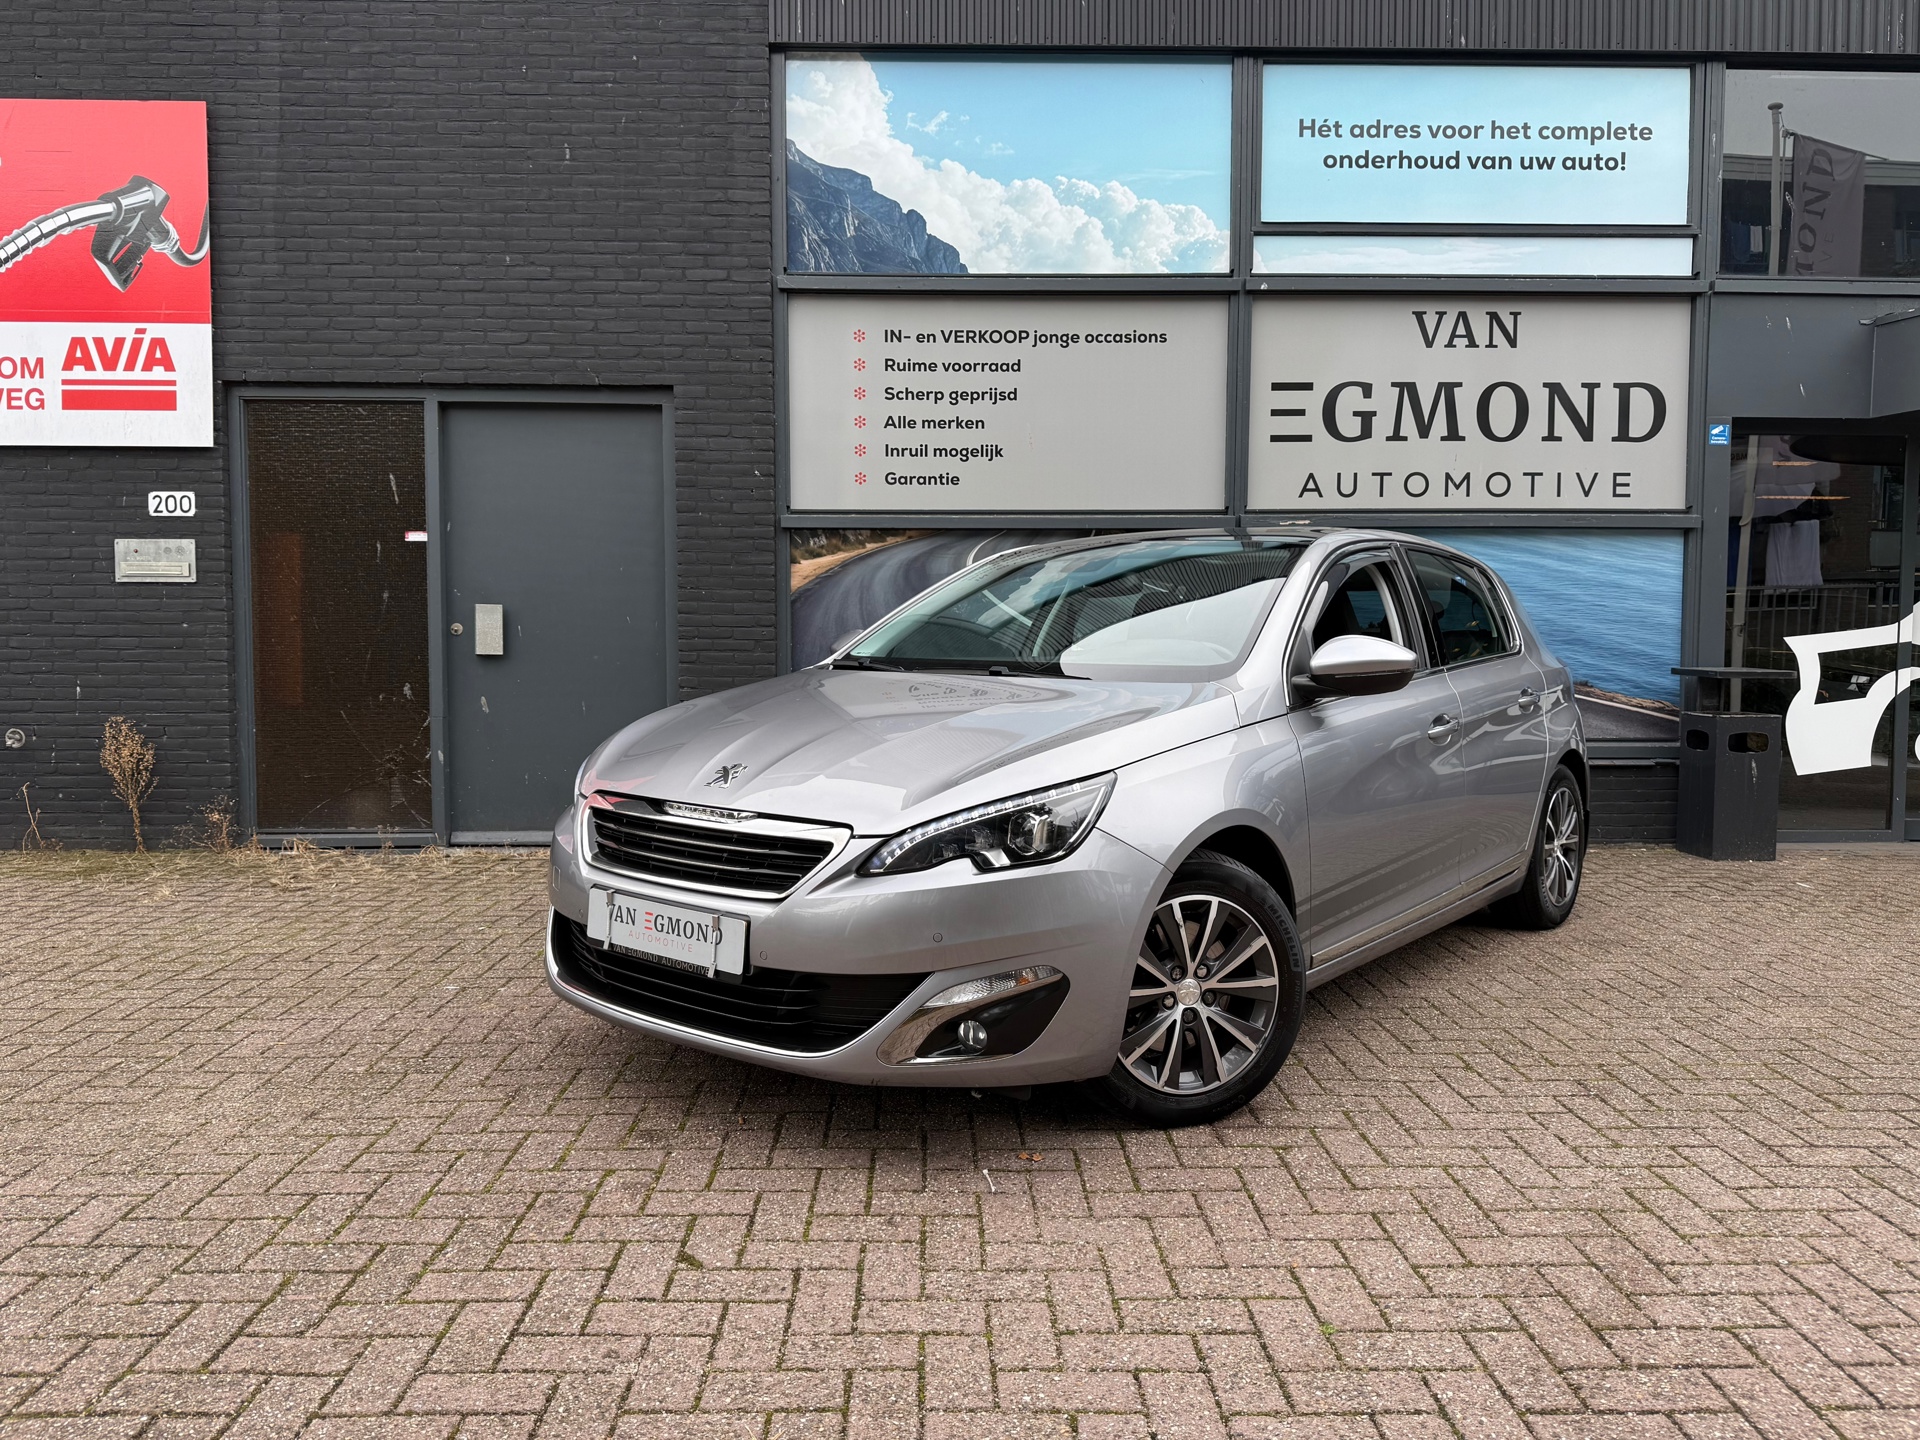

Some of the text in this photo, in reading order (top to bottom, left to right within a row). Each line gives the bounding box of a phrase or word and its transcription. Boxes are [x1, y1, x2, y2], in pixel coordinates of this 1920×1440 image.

[1299, 119, 1653, 145] Hét adres voor het complete
[1323, 150, 1626, 171] onderhoud van uw auto!
[884, 330, 1167, 348] IN- en VERKOOP jonge occasions
[1412, 311, 1521, 348] VAN
[884, 358, 1021, 373] Ruime voorraad
[884, 387, 1018, 405] Scherp geprijsd
[1270, 381, 1667, 442] EGMOND
[884, 416, 985, 430] Alle merken
[885, 444, 1003, 461] Inruil mogelijk
[885, 472, 960, 486] Garantie
[1299, 472, 1631, 498] AUTOMOTIVE
[152, 494, 192, 514] 200
[644, 911, 723, 946] EGMOND
[1267, 903, 1300, 968] MICHELIN
[629, 930, 693, 952] AUTOMOTIVE
[612, 945, 710, 976] VAN EGMOND AUTOMOTIVE
